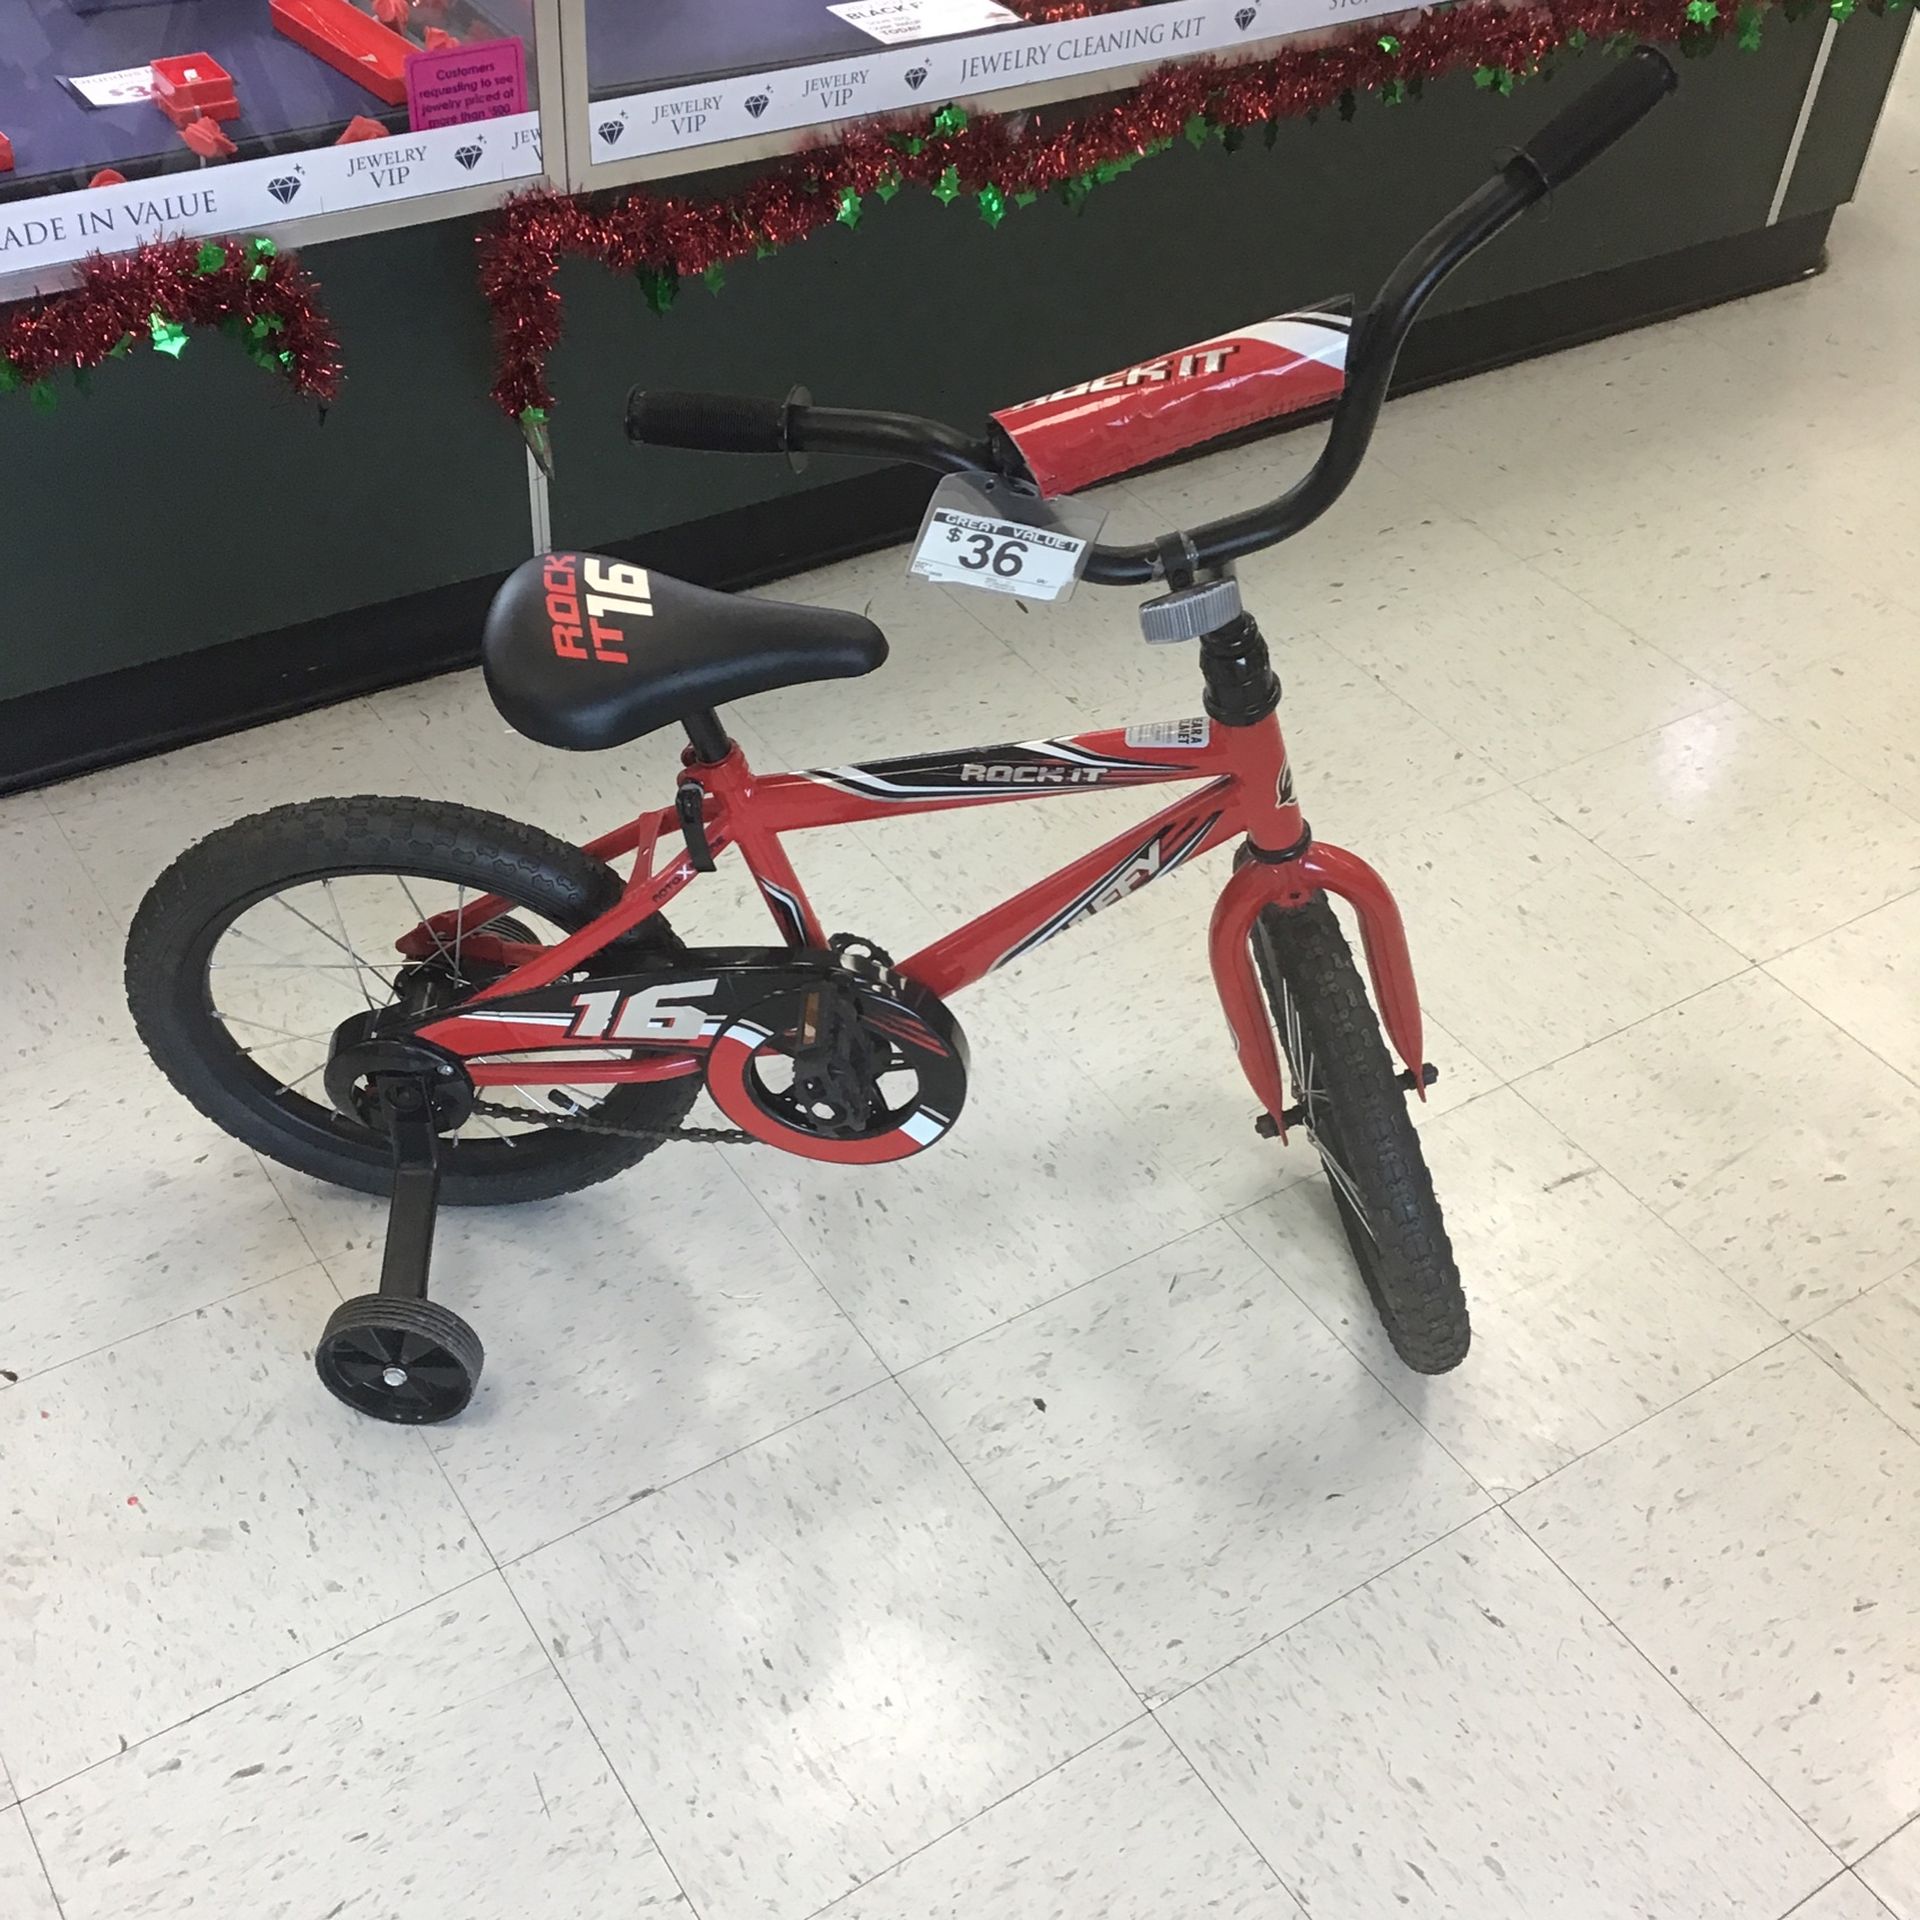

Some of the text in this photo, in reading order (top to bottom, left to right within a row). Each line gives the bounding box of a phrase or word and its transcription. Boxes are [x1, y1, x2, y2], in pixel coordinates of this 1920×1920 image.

[845, 4, 905, 20] BLACK
[960, 16, 1206, 84] JEWELRY CLEANING KIT
[436, 62, 495, 81] Customers
[801, 69, 870, 97] JEWELRY
[419, 75, 513, 98] requesting to see
[820, 88, 854, 109] VIP
[422, 88, 514, 117] jewelry priced at
[461, 110, 486, 122] than
[651, 95, 723, 124] JEWELRY
[671, 114, 707, 135] VIP
[347, 146, 428, 177] JEWELRY
[370, 166, 411, 188] VIP
[0, 190, 218, 250] ADE IN VALUE
[1178, 345, 1240, 377] IT
[945, 513, 1000, 534] GREAT
[543, 554, 589, 660] ROCK
[584, 558, 654, 664] IT 16
[959, 763, 1110, 784] ROCK IT
[572, 978, 720, 1041] 16
